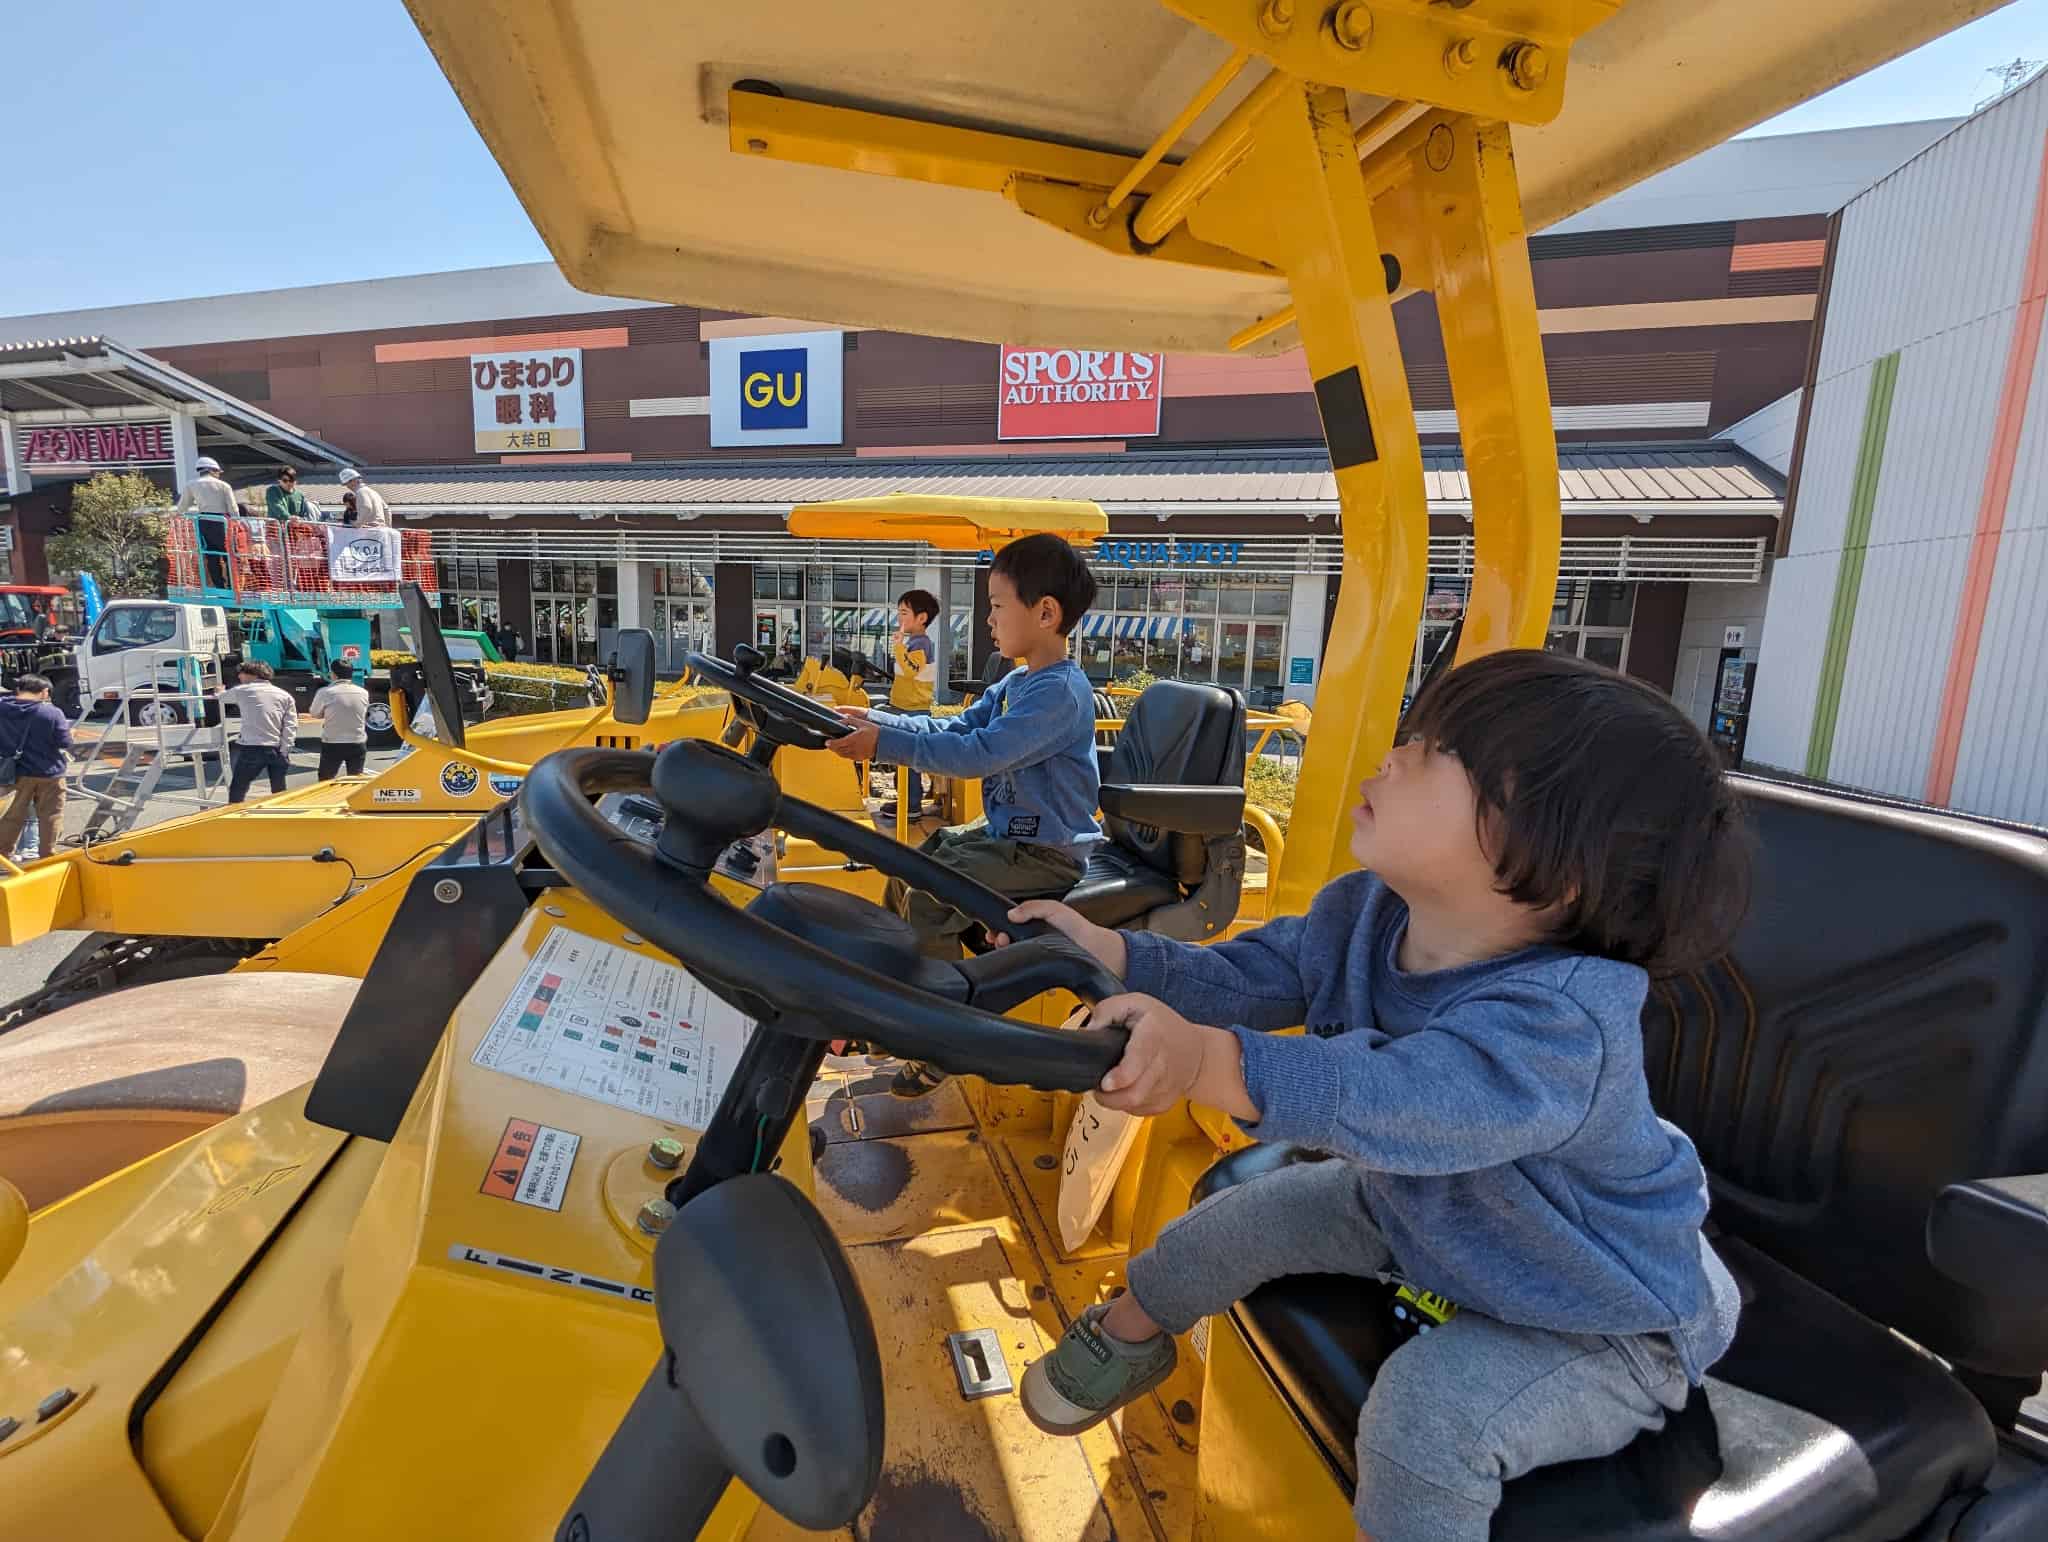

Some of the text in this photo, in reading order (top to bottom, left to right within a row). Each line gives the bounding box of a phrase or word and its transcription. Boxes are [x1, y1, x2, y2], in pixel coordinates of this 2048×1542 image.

[472, 356, 575, 390] ひまわり
[1004, 349, 1155, 385] SPORTS
[744, 371, 802, 408] GU
[495, 392, 557, 424] 眼科
[95, 425, 170, 460] MALL
[505, 431, 551, 448] 大牟田
[1095, 541, 1244, 569] AQUA SPOT
[379, 789, 415, 797] NETIS
[463, 1248, 655, 1302] F N R
